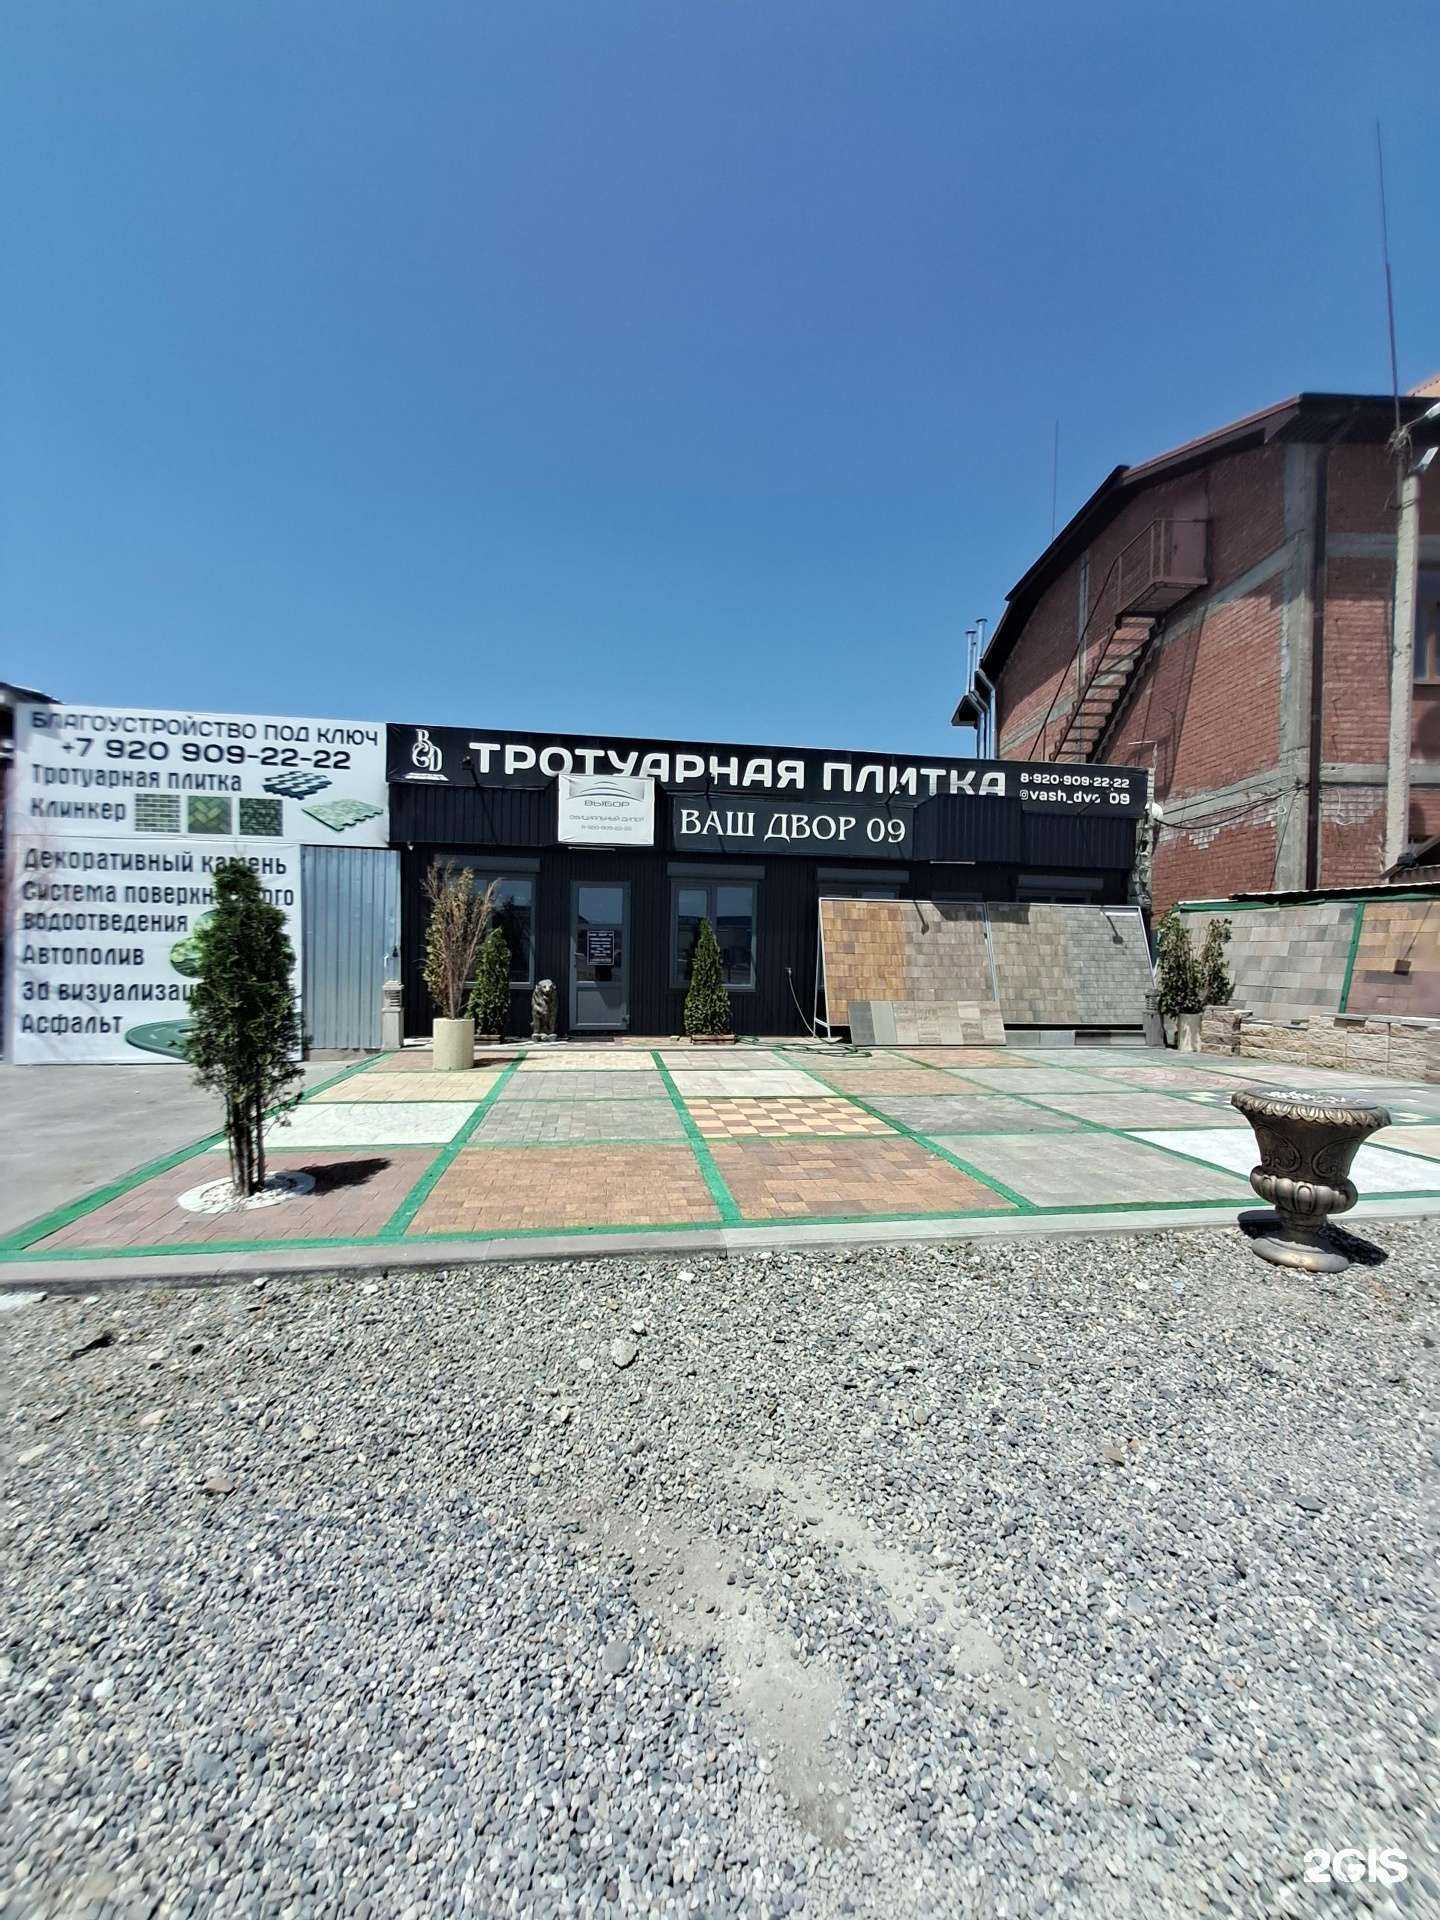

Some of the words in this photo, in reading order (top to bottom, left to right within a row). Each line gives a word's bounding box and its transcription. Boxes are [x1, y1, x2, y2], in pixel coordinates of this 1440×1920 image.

[31, 711, 257, 742] БЛАГОУСТРОЙСТВО
[264, 724, 310, 743] ПОД
[317, 727, 379, 747] КЛЮЧ
[62, 737, 95, 757] +7
[106, 739, 169, 760] 920
[182, 743, 352, 770] 909-22-22
[32, 763, 162, 789] Тротуарная
[168, 771, 243, 793] плитка
[469, 742, 805, 790] ТРОТУАРНАЯ
[823, 760, 1007, 796] ПЛИТКА
[31, 798, 127, 822] Клинкер
[680, 808, 756, 838] ВАШ
[763, 812, 857, 845] ДВОР
[866, 817, 907, 844] 09
[24, 848, 194, 876] Декоративный
[23, 881, 118, 903] Система
[23, 910, 189, 933] водоотведения
[23, 945, 145, 966] Автополив
[22, 1013, 124, 1036] Асфальт
